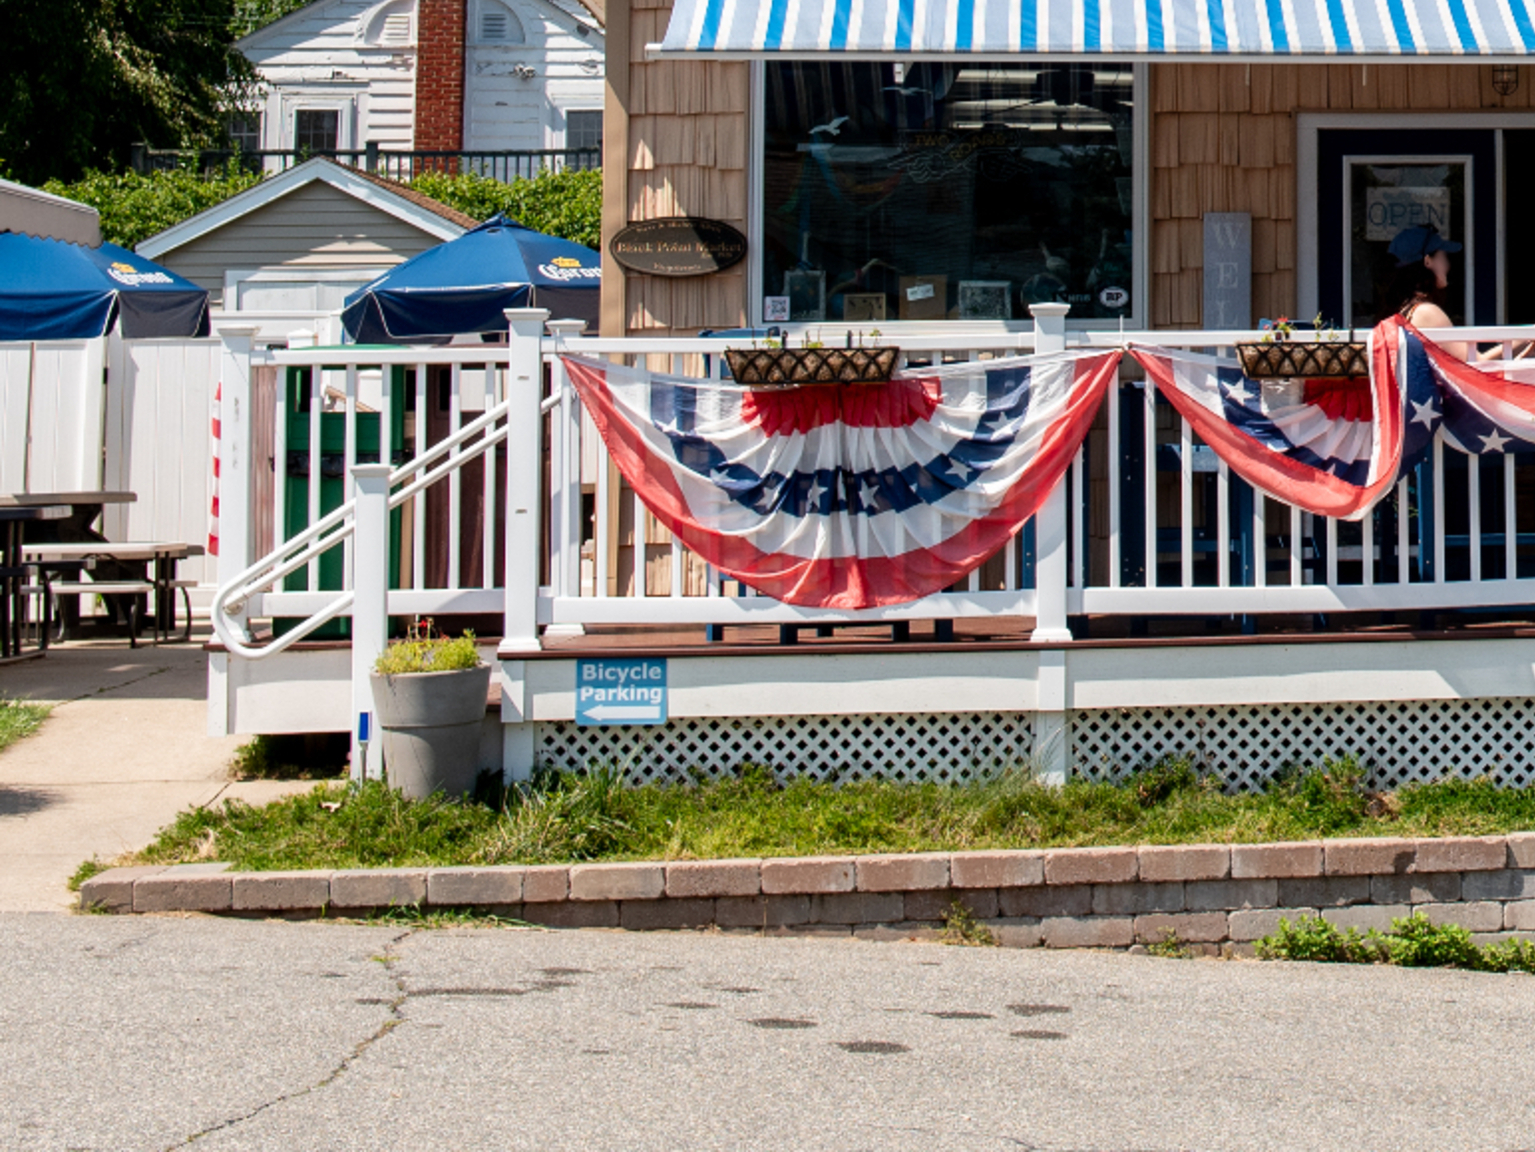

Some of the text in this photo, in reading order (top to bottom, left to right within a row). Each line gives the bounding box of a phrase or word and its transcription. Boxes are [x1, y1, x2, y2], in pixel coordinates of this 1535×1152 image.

[1368, 201, 1447, 226] OPEN
[538, 263, 602, 282] Coron
[582, 662, 662, 683] Bicycle
[580, 684, 662, 705] Parking
